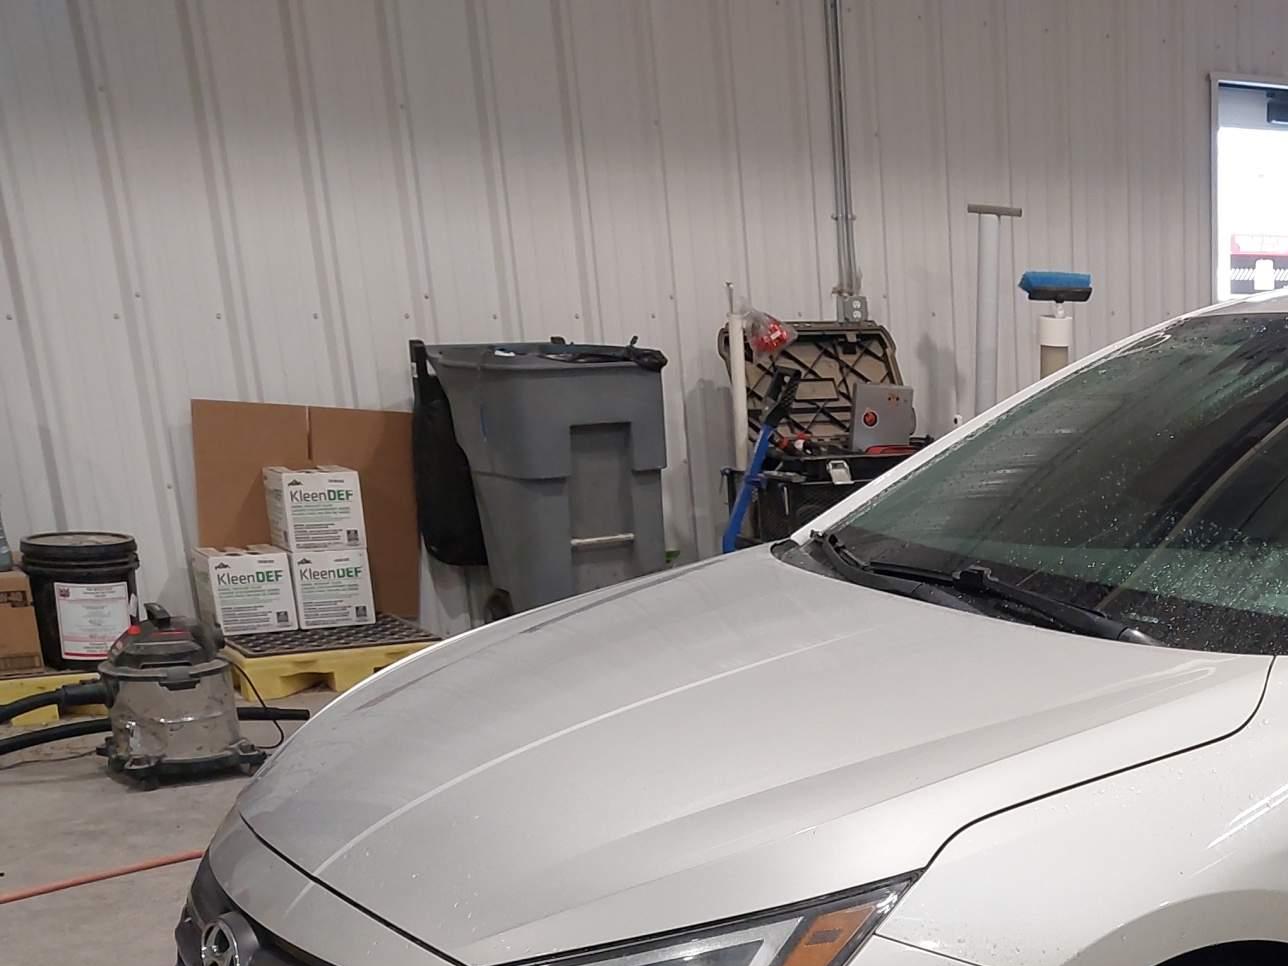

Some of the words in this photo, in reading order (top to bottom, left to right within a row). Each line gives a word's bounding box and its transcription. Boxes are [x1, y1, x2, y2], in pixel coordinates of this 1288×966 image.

[290, 489, 353, 502] KleenDEF
[217, 570, 283, 585] KleenDEF
[300, 567, 362, 580] KleenDEF
